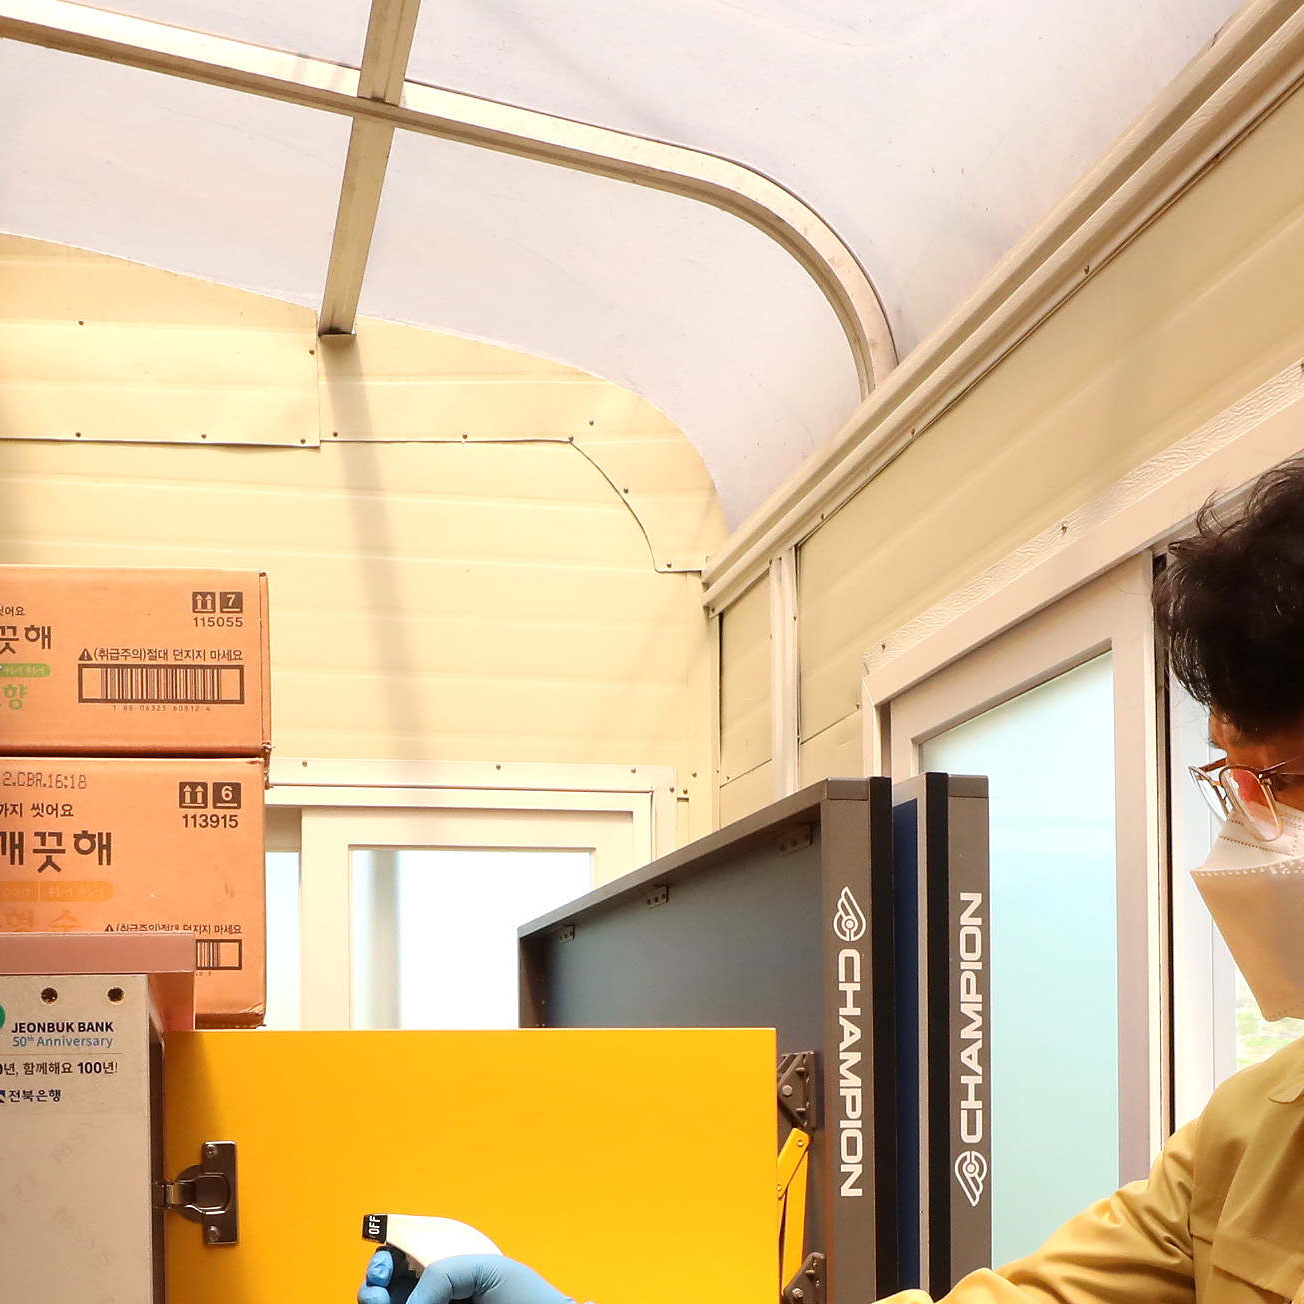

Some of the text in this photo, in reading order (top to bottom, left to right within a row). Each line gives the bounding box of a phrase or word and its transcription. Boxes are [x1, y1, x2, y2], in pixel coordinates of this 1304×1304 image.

[226, 594, 236, 607] 7
[192, 616, 244, 628] 115055
[172, 648, 206, 661] 던지지
[209, 648, 244, 662] 마세요
[220, 785, 233, 801] 6
[30, 803, 75, 818] 씻어요
[181, 813, 239, 829] 113915
[214, 924, 243, 935] 마세요
[959, 892, 983, 1144] CHAMPION
[11, 1021, 114, 1033] JEONBUK BANK
[12, 1036, 114, 1049] 50th Anniversary
[23, 1062, 74, 1076] 함께해요
[77, 1061, 119, 1075] 100년!
[838, 948, 863, 1197] CHAMPION
[8, 1089, 62, 1103] 전북은행
[368, 1215, 381, 1235] OFF
